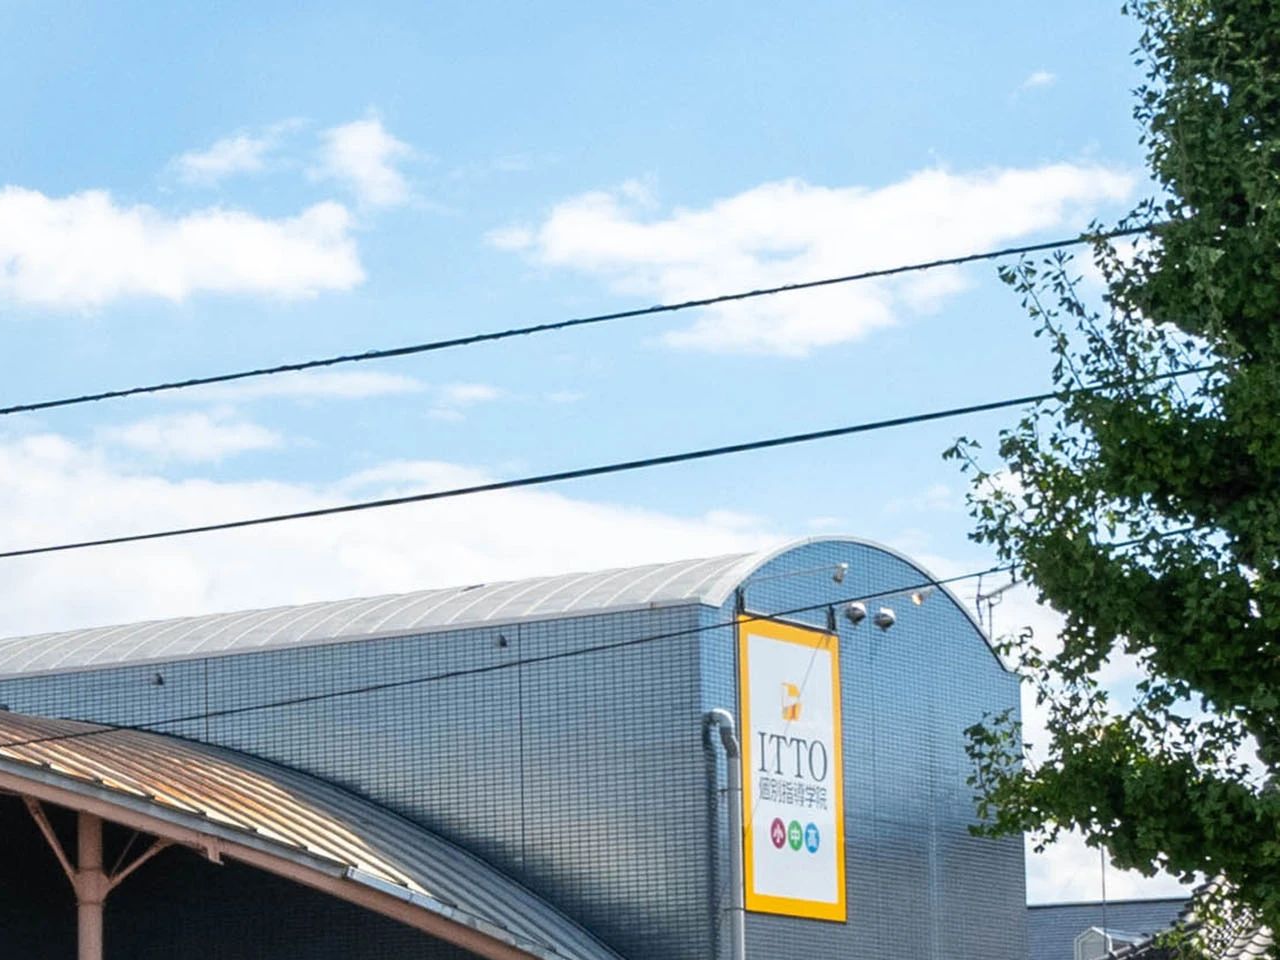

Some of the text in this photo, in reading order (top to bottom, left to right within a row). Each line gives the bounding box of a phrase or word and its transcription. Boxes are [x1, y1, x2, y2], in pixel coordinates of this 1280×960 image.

[758, 731, 829, 782] ITTO
[758, 776, 829, 811] 個別指導学院
